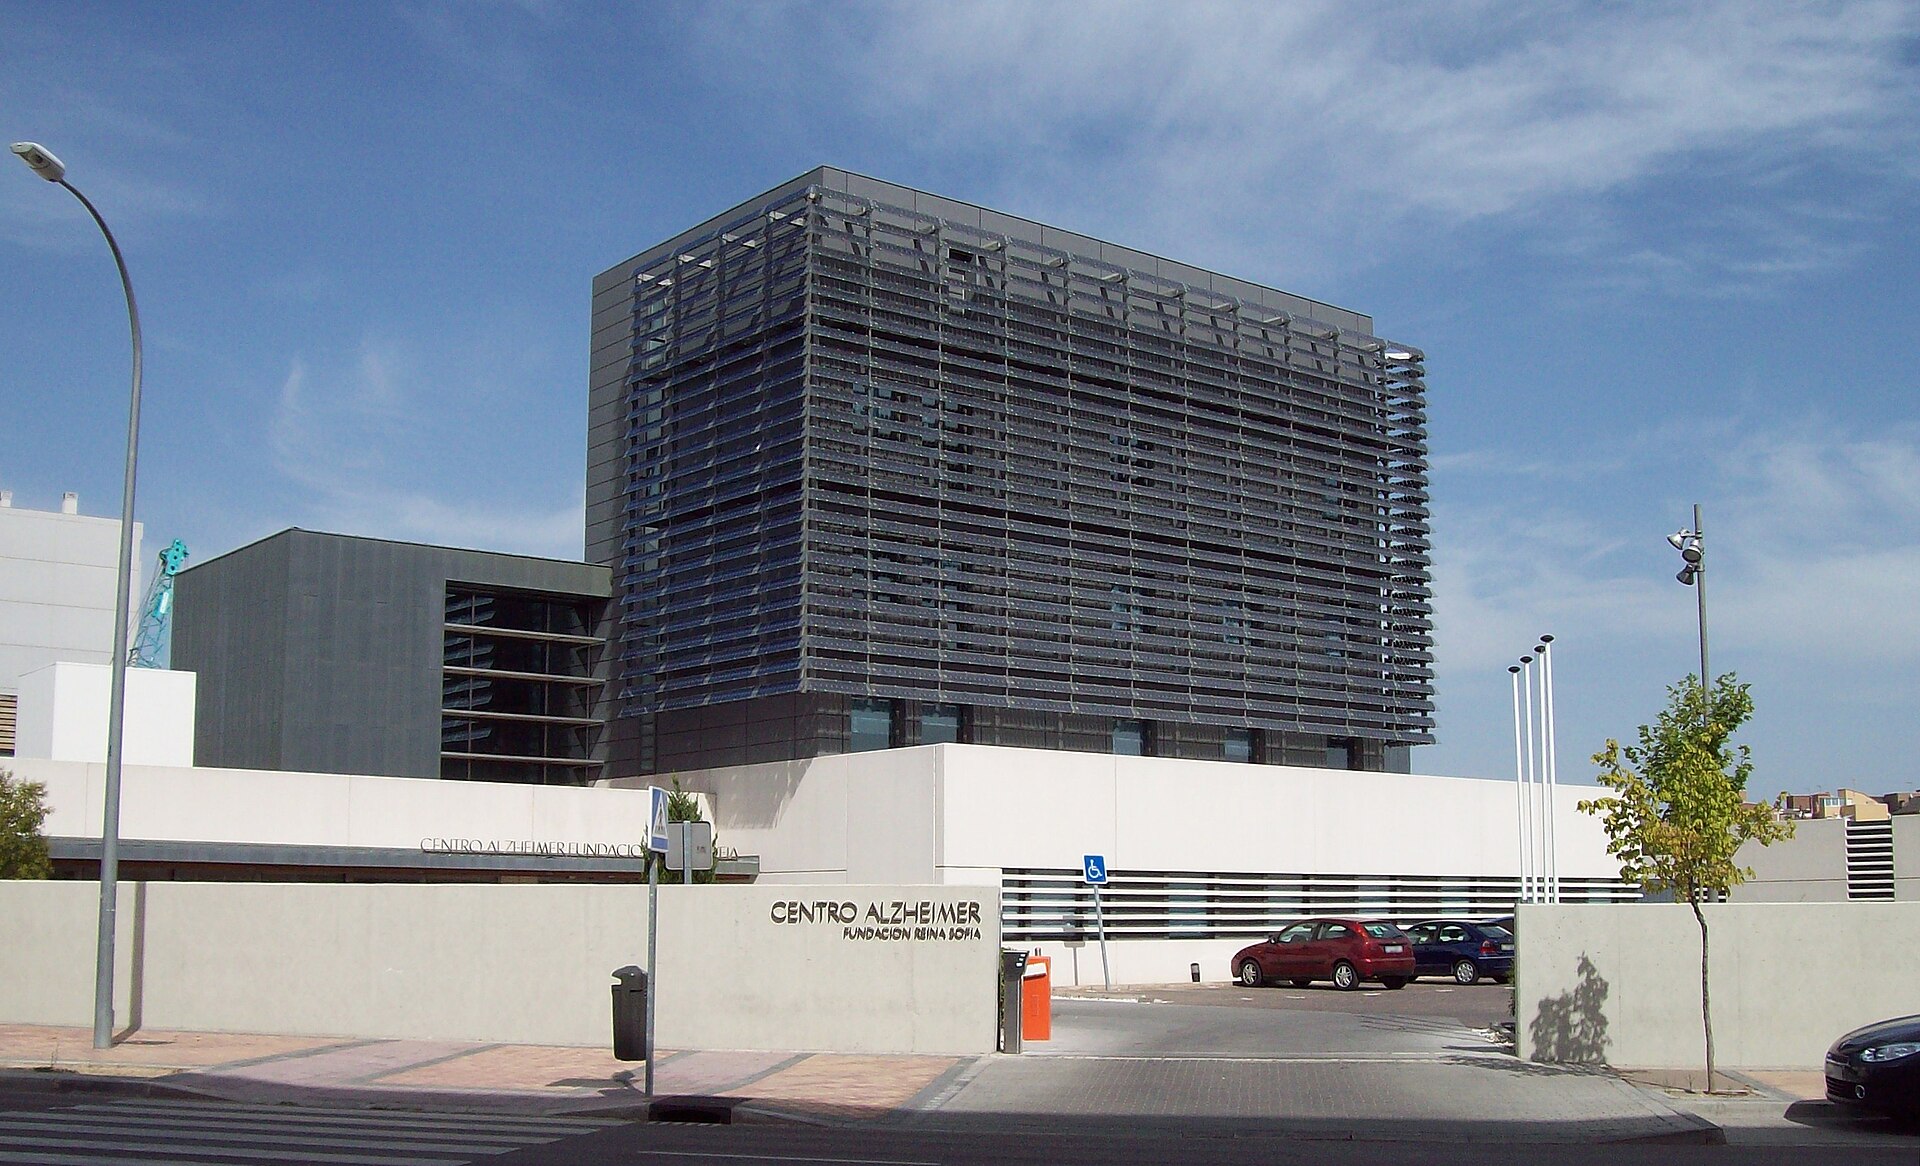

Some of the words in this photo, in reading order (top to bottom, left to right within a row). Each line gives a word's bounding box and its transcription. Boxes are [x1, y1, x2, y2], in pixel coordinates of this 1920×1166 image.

[420, 837, 483, 853] CENTRO
[487, 839, 567, 857] ALZHEIMER
[568, 841, 644, 858] FUNDACIO
[770, 901, 857, 924] CENTRO
[864, 901, 982, 925] ALZHEIMER
[843, 927, 911, 941] FUNDACION
[914, 927, 946, 941] REINA
[949, 927, 982, 941] SOFIA
